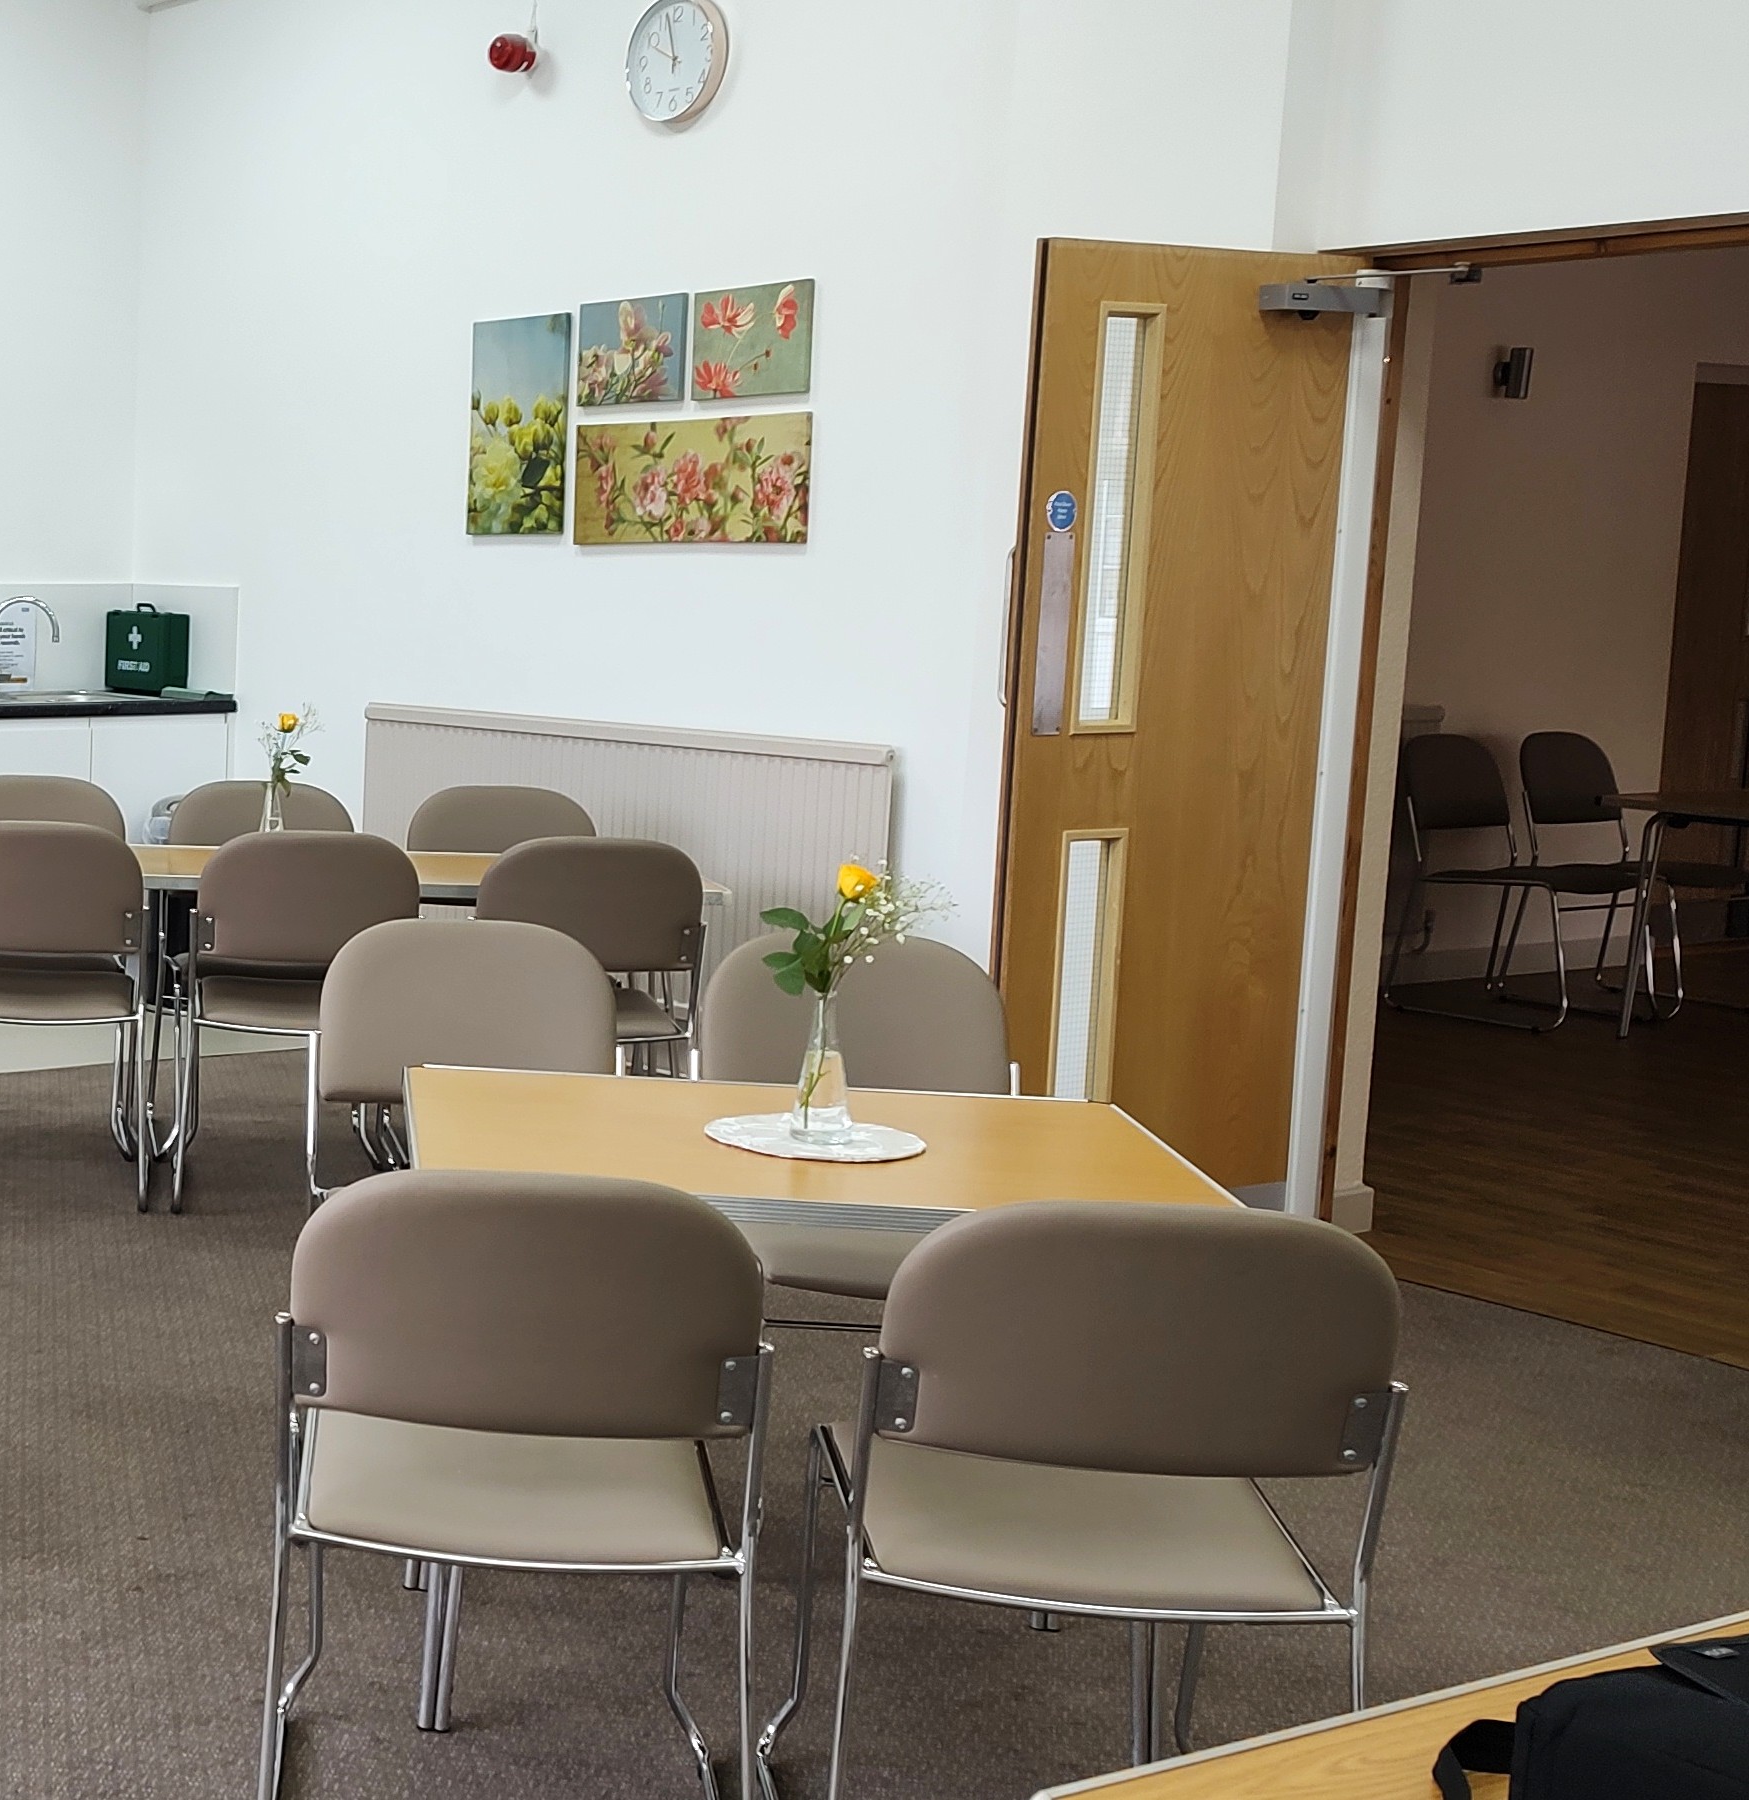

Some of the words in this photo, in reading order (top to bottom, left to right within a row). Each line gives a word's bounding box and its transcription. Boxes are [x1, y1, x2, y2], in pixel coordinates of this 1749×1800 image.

[673, 6, 684, 23] 12
[648, 31, 660, 49] 10
[639, 55, 648, 72] 9
[698, 69, 706, 84] 4
[643, 77, 652, 94] 8
[656, 91, 663, 108] 7
[668, 94, 677, 112] 6
[685, 86, 694, 103] 5
[117, 659, 139, 671] FIRST
[138, 661, 150, 673] AID
